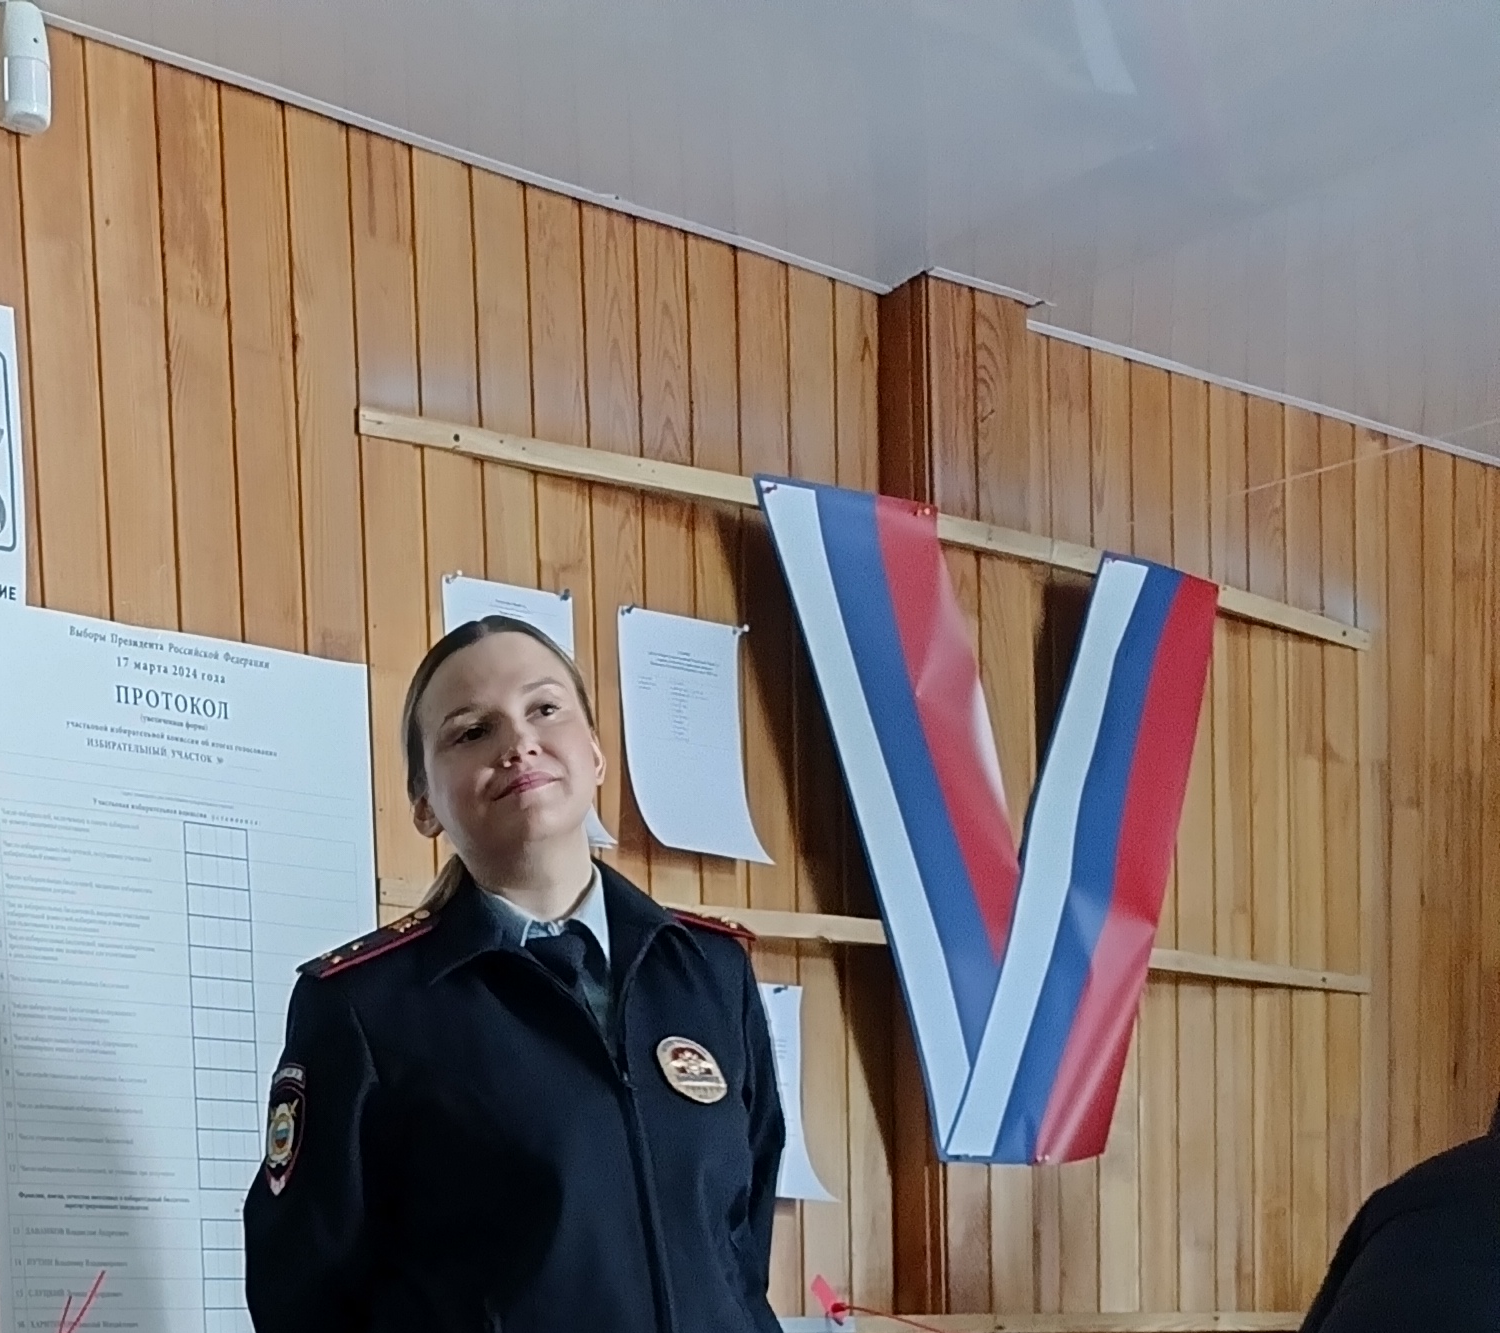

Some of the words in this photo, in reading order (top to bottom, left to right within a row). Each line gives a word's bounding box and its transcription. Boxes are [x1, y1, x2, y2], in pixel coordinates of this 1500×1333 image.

[69, 625, 107, 643] Выборы
[110, 633, 164, 652] Президента
[168, 643, 220, 661] Российской
[223, 652, 270, 670] Федерации
[116, 656, 130, 668] 17
[133, 661, 168, 676] марта
[172, 665, 198, 680] 2024
[201, 671, 226, 684] года
[115, 685, 230, 720] ПРОТОКОЛ
[86, 738, 167, 757] ИЗБИРАТЕЛЬНЫЙ
[171, 749, 213, 764] УЧАСТОК
